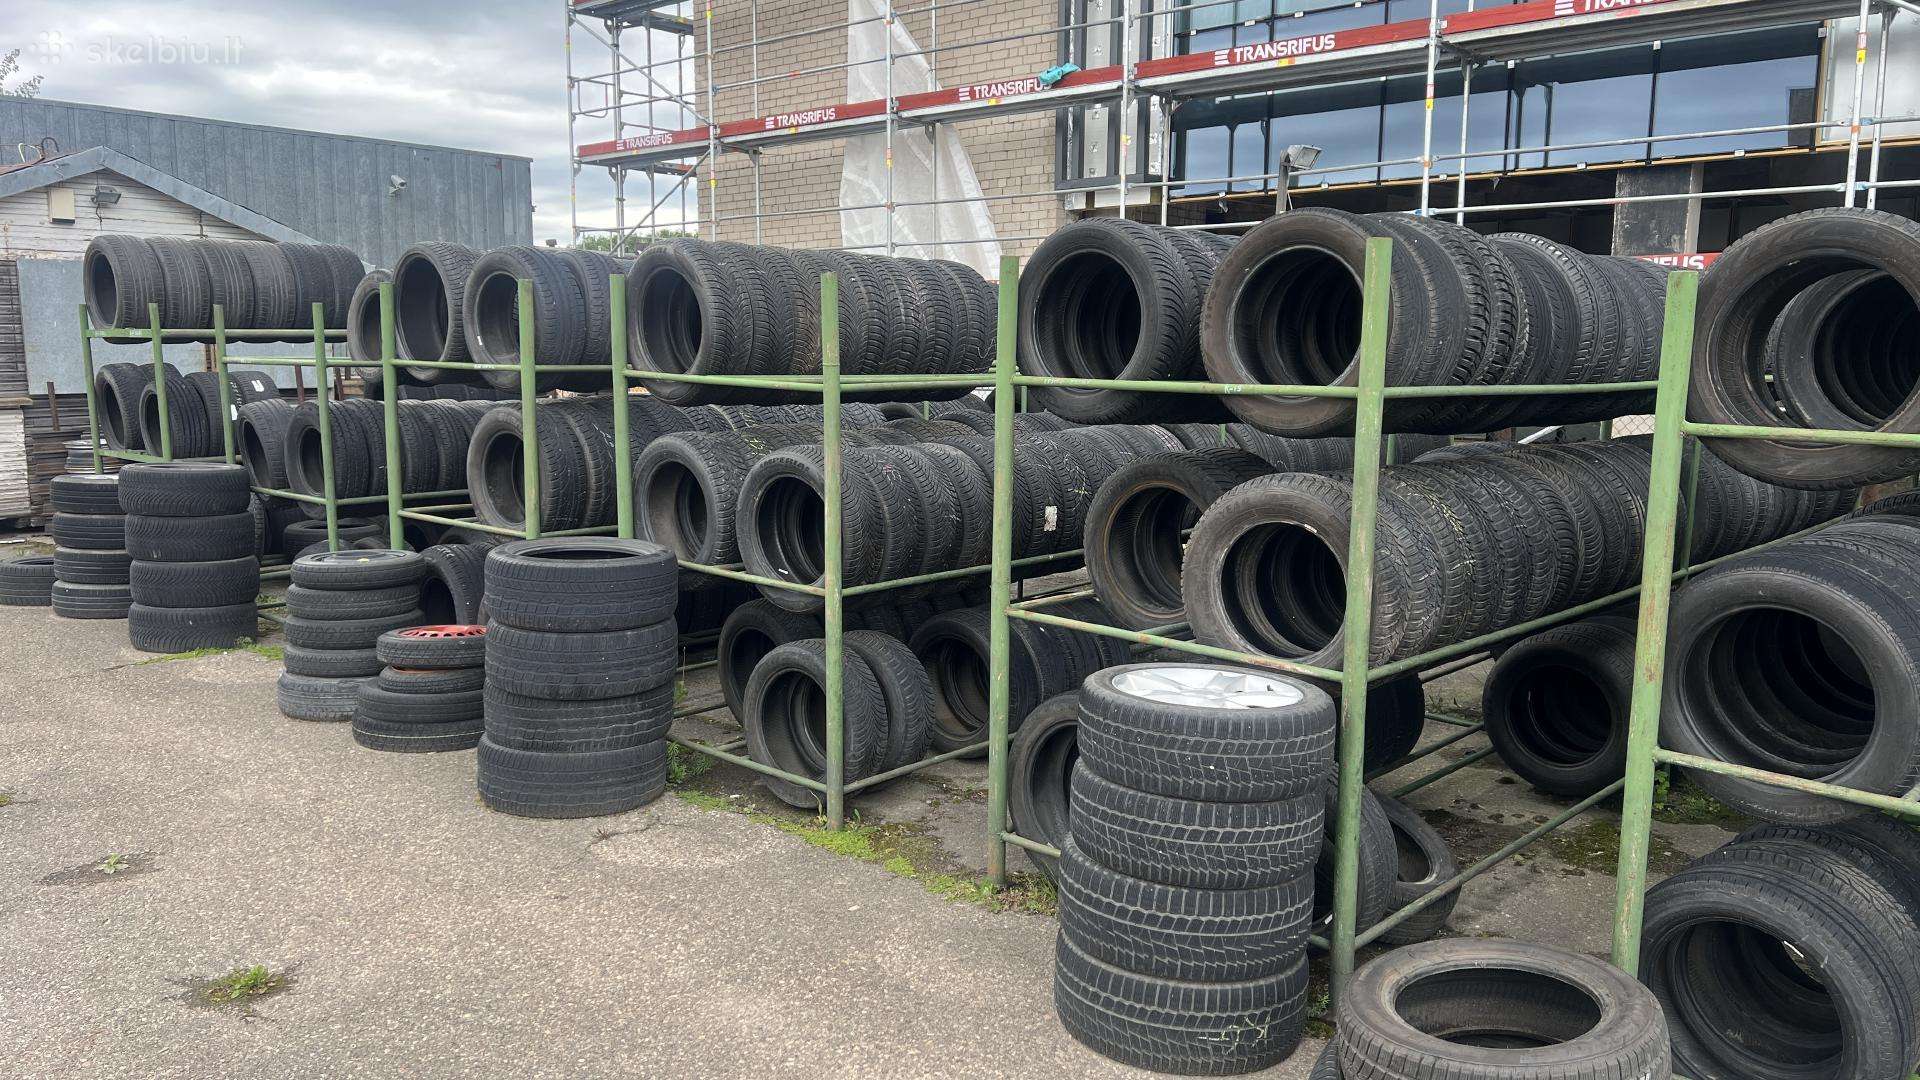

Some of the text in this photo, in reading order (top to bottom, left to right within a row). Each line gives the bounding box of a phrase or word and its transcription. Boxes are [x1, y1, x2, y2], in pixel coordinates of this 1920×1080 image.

[1233, 34, 1336, 63] TRANSRIFUS
[973, 78, 1051, 99] TRANSRIFU
[776, 107, 836, 127] TRANSRIFUS
[624, 133, 673, 150] TRANSRIFUS
